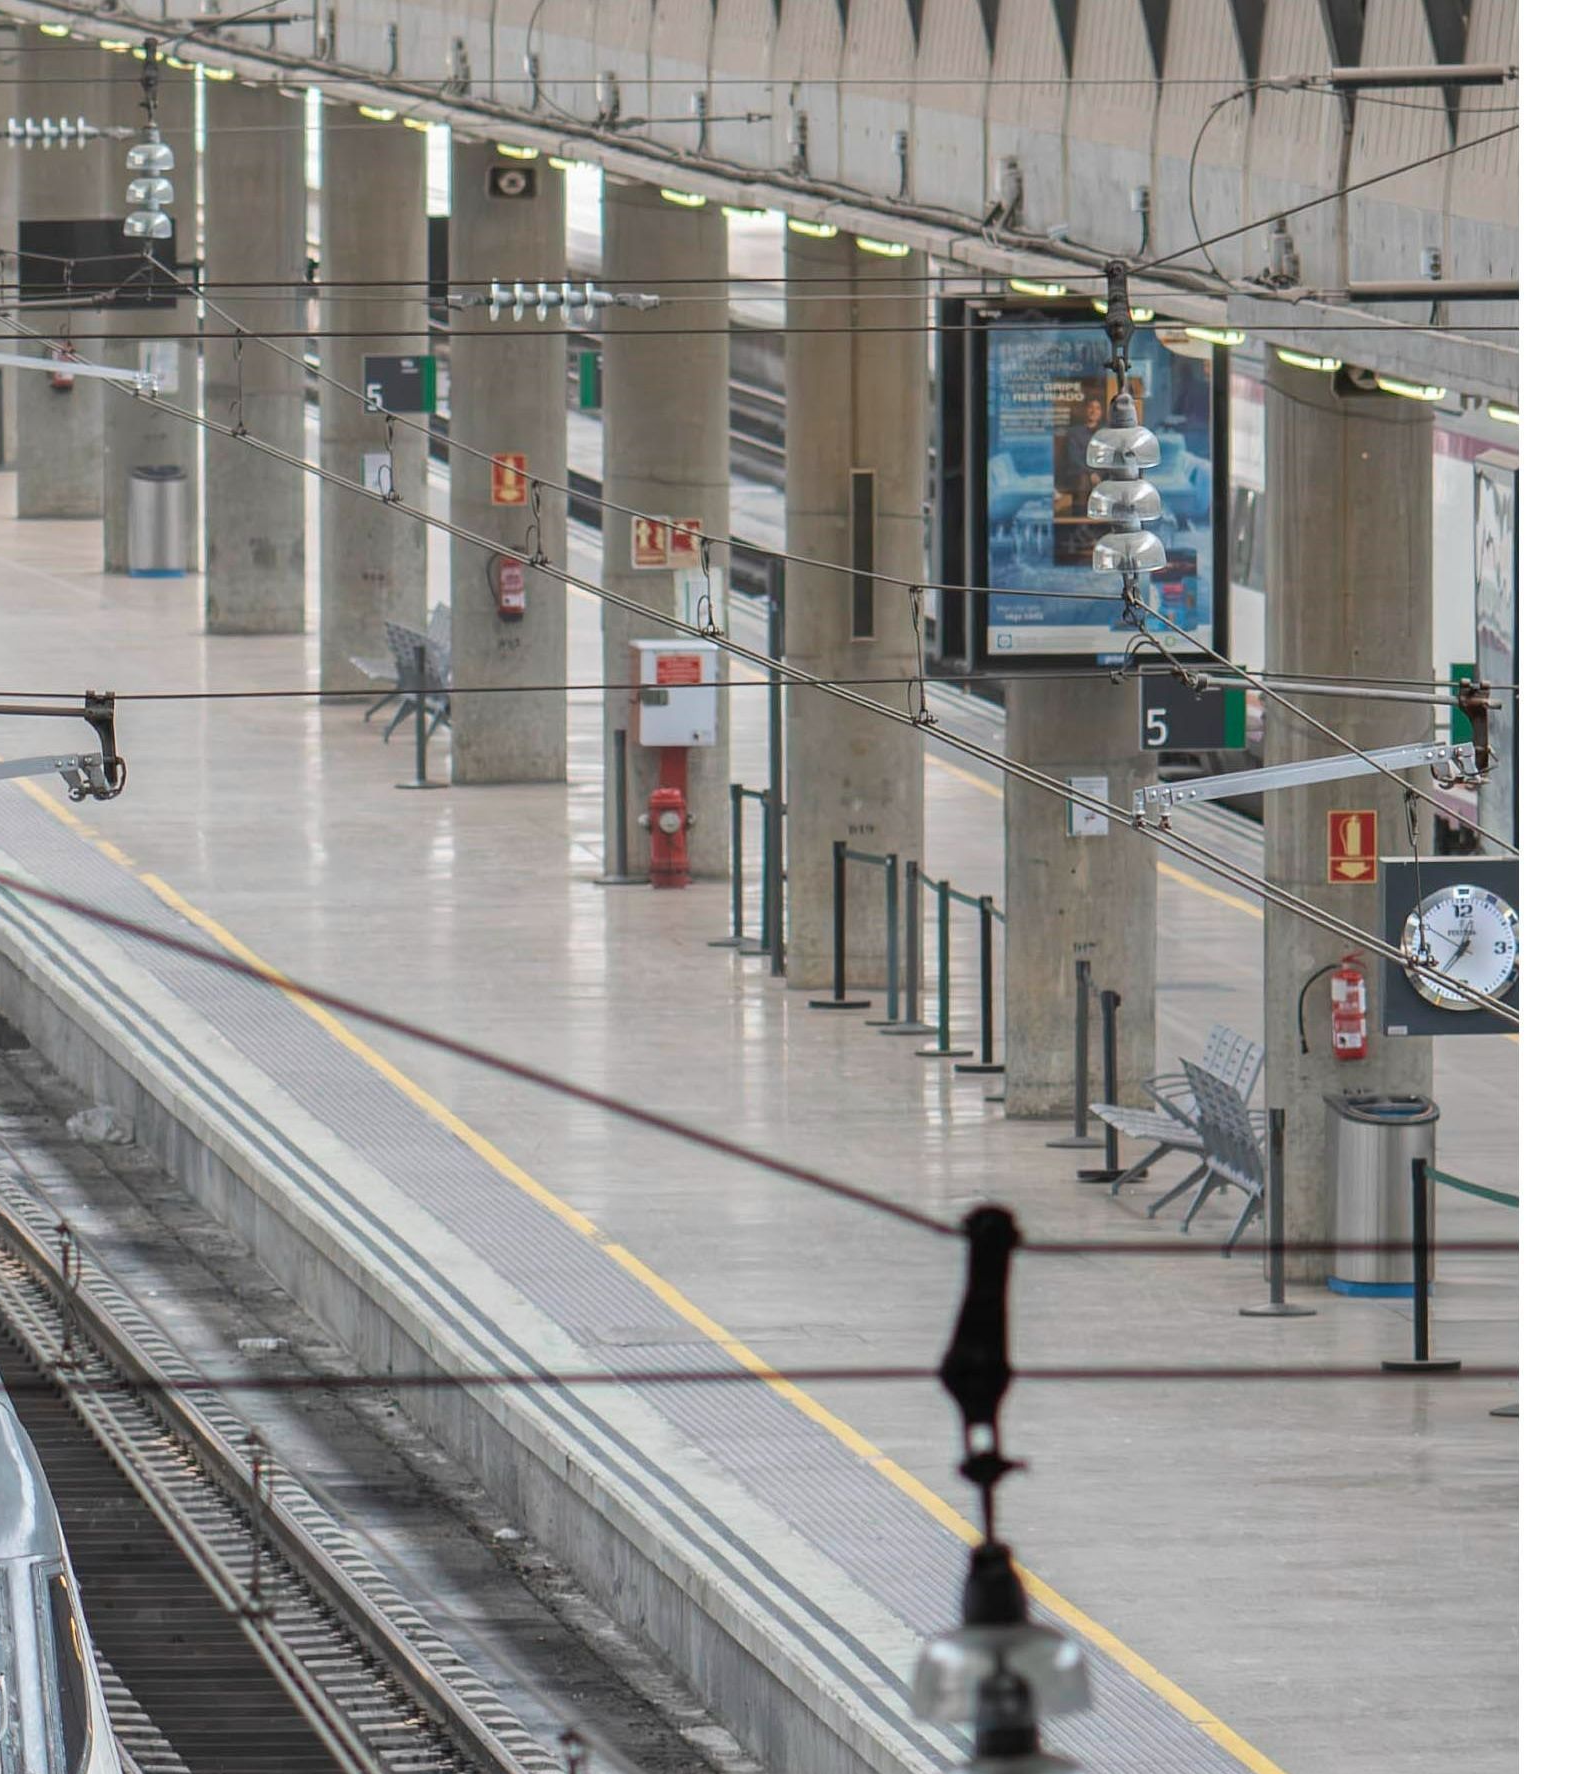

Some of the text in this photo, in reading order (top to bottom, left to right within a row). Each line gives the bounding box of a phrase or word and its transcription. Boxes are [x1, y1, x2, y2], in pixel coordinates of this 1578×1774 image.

[367, 383, 383, 411] 5
[1012, 393, 1085, 402] RESFRIADO
[1147, 708, 1167, 746] 5
[1453, 904, 1473, 918] 12
[1494, 941, 1507, 955] 3
